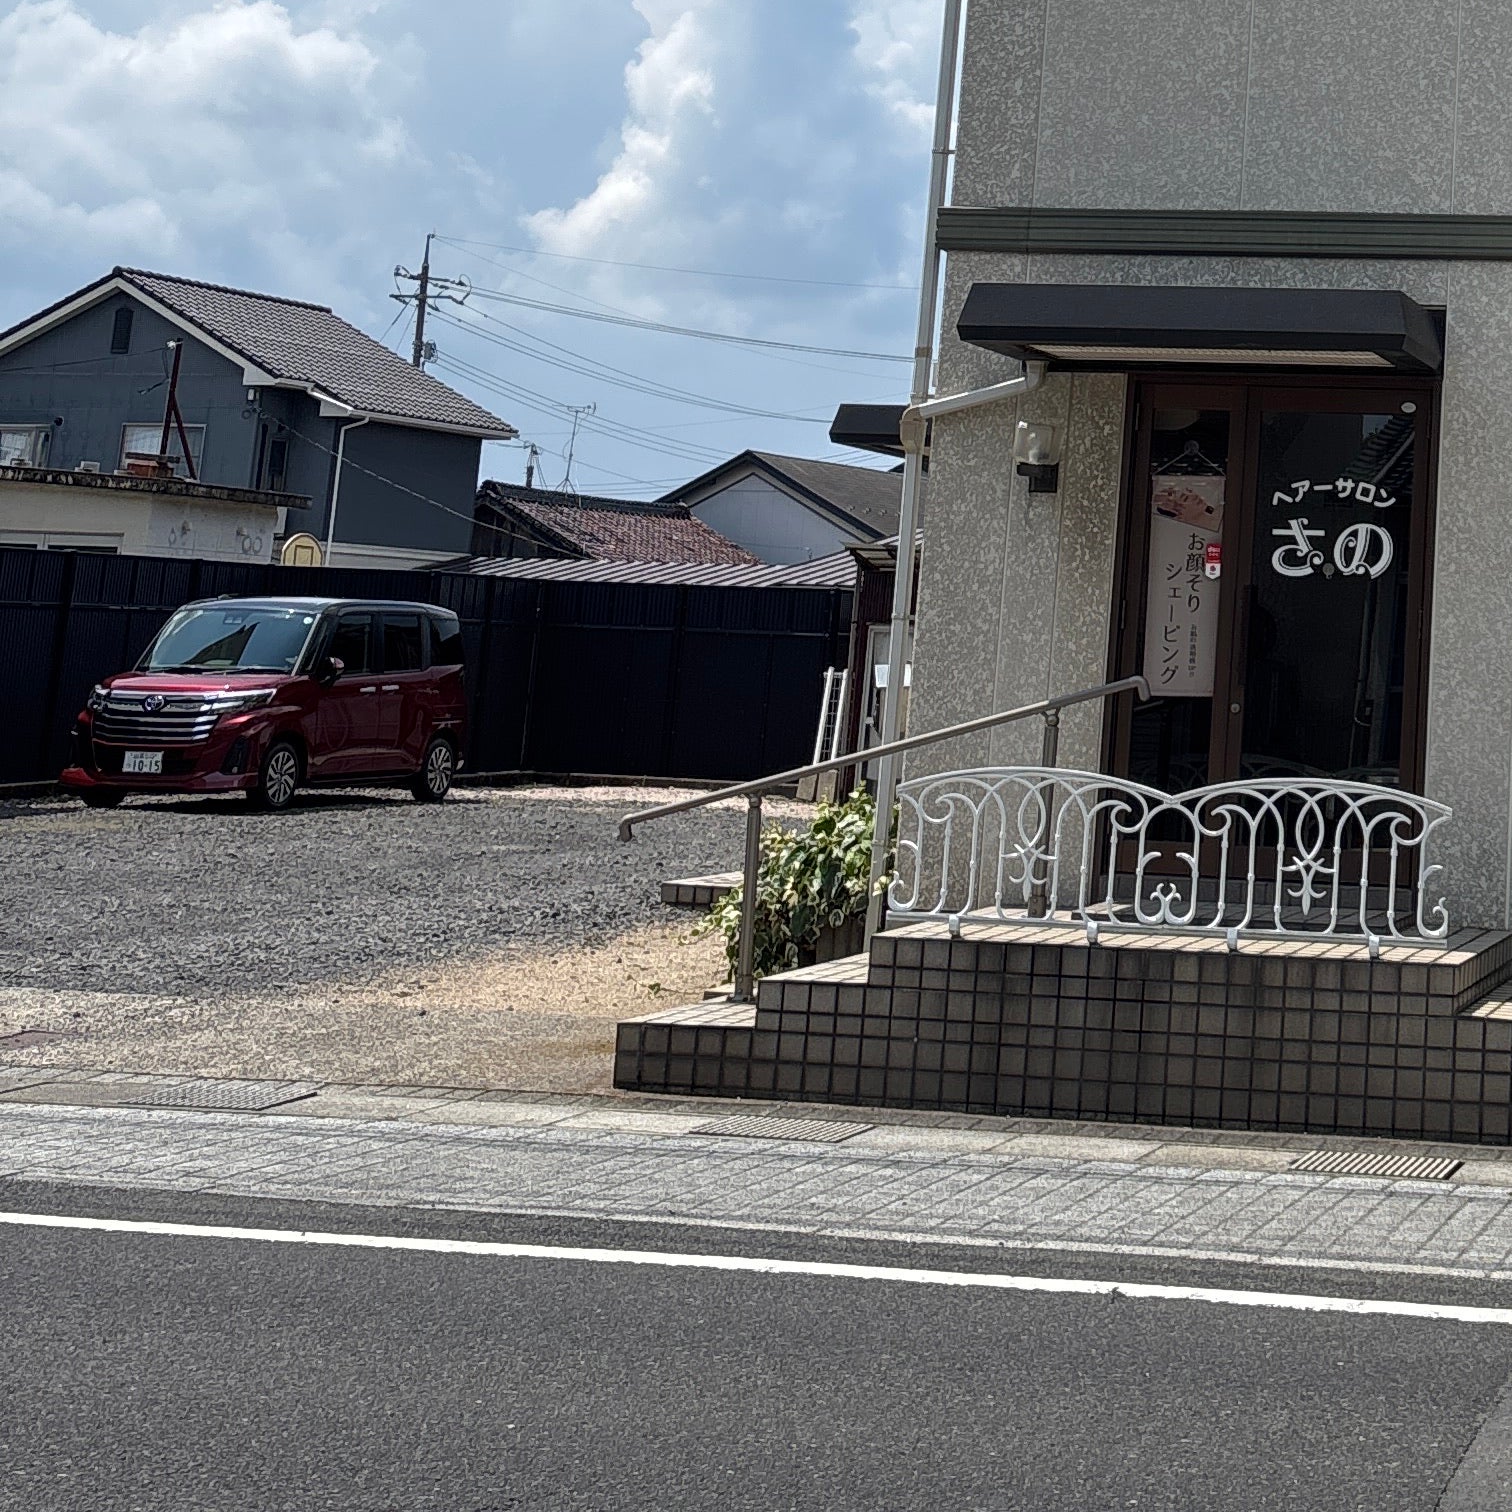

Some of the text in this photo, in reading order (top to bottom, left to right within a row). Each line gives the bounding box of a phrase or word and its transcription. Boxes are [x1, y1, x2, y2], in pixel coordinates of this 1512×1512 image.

[1272, 477, 1397, 508] ヘアーサロン
[1186, 532, 1206, 613] お顔そり
[1271, 517, 1394, 580] さの
[1160, 563, 1183, 685] シェービング
